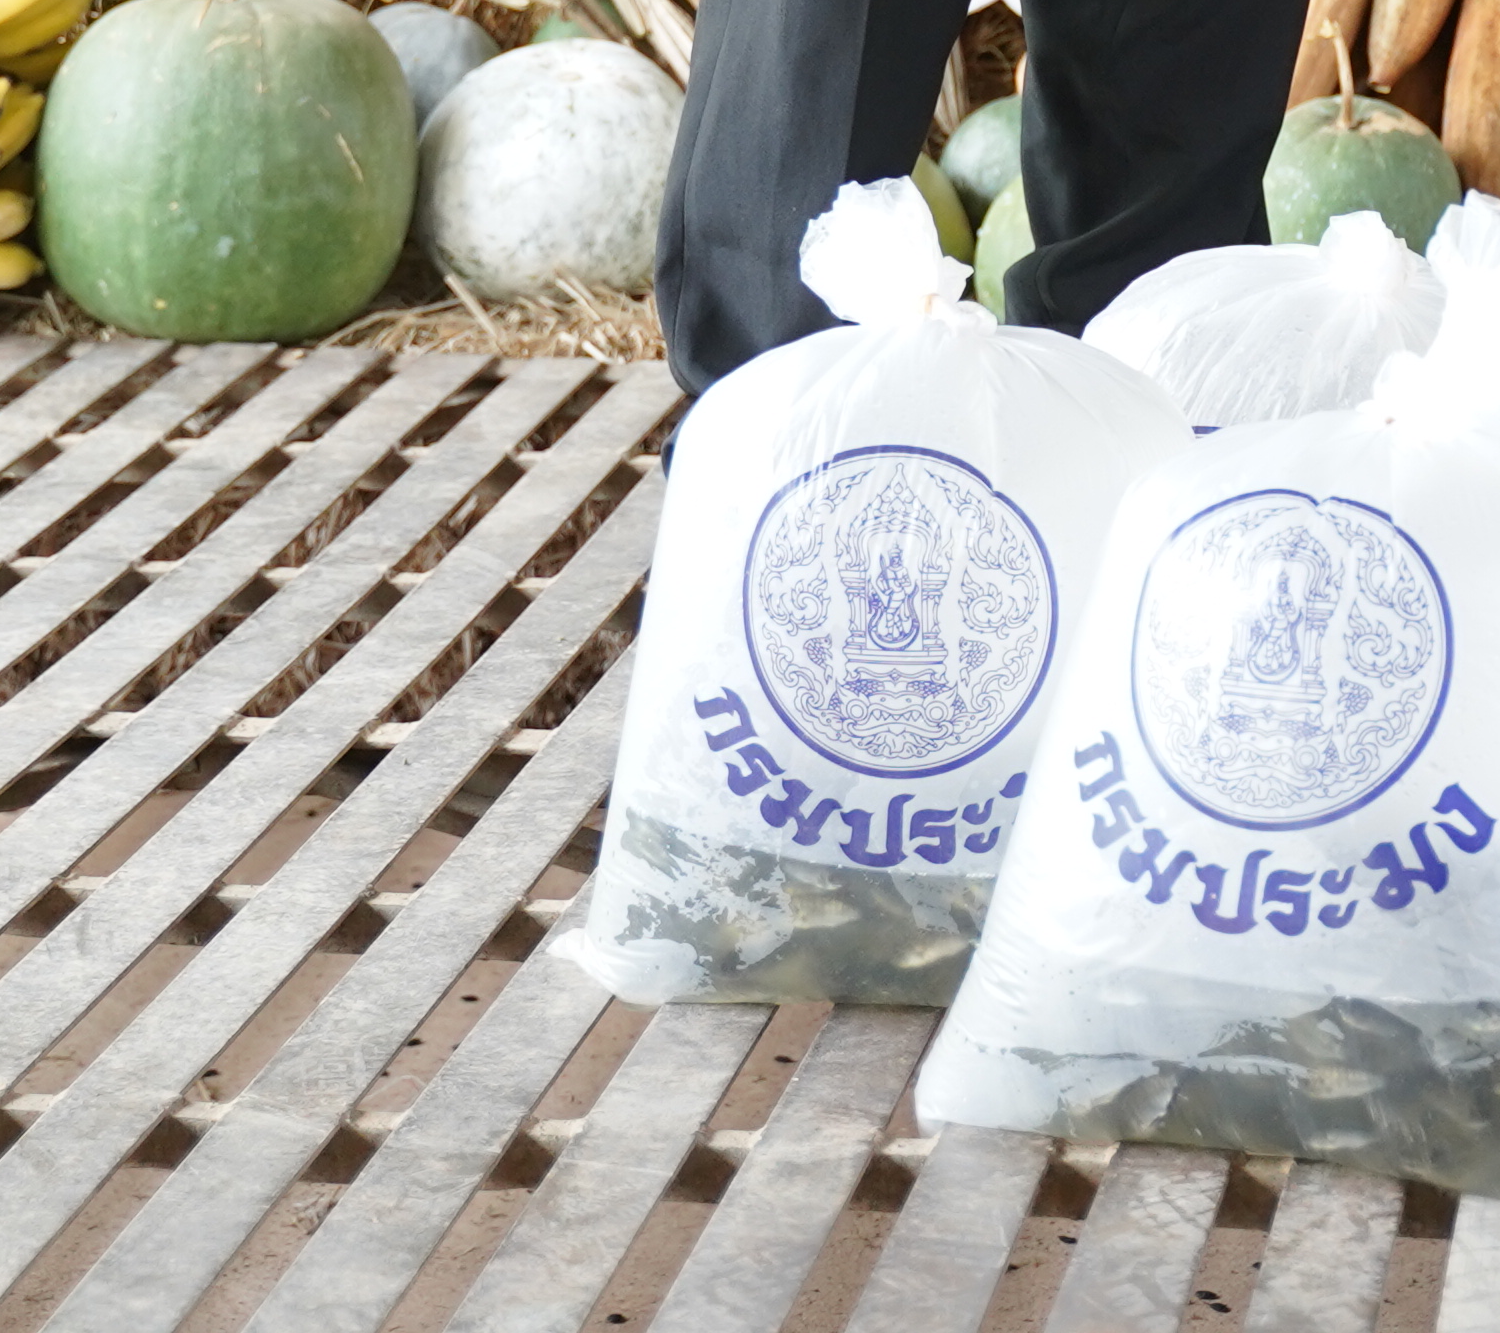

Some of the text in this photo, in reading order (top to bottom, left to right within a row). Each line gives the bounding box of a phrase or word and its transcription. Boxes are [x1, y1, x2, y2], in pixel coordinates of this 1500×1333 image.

[693, 684, 1028, 867] กรมประ
[1073, 729, 1499, 937] กรมประมง
